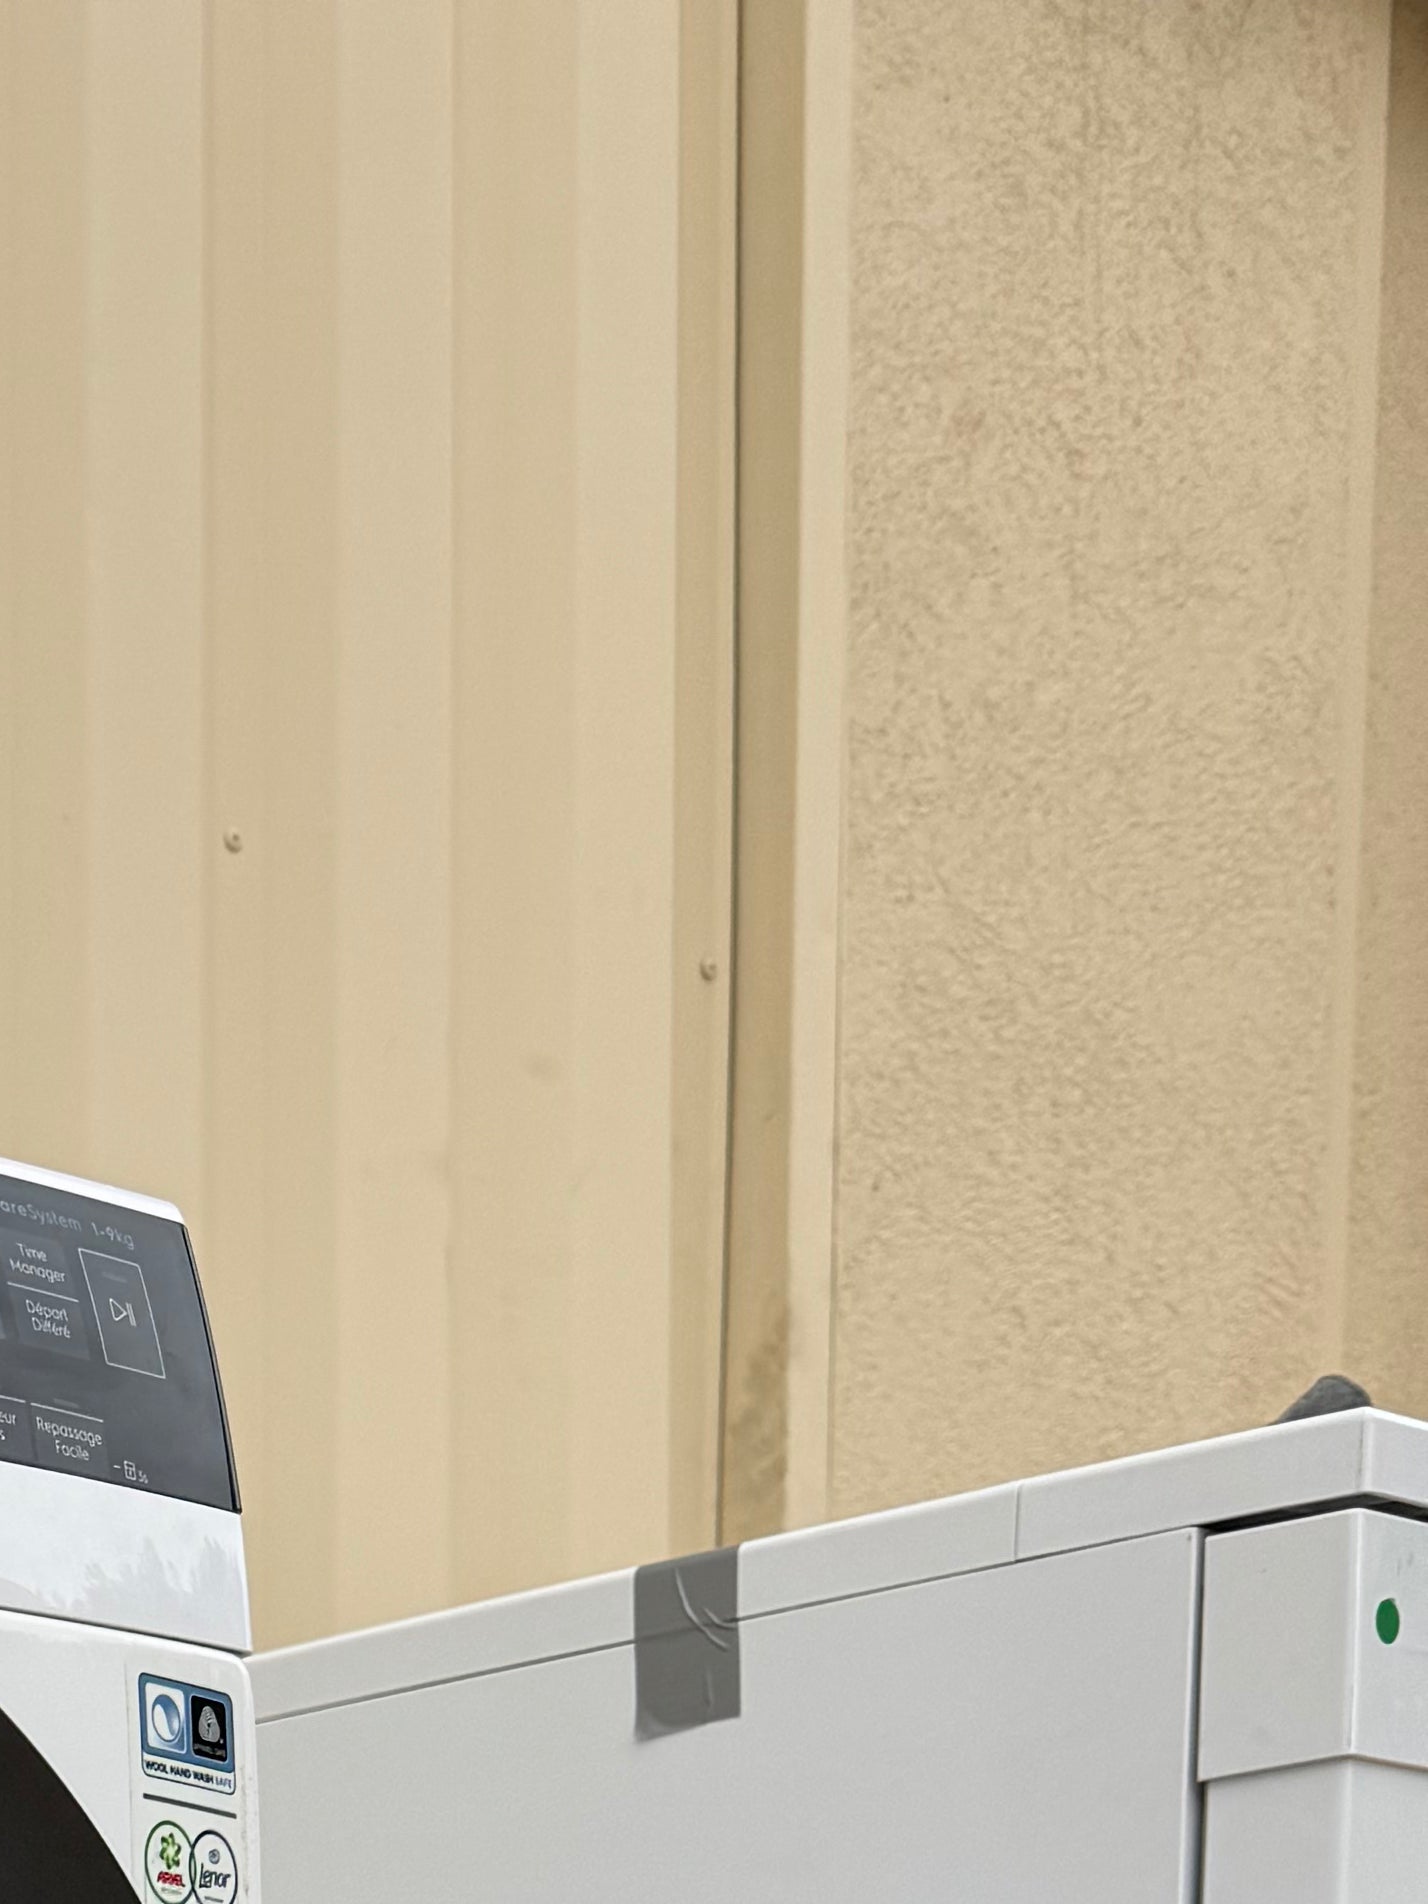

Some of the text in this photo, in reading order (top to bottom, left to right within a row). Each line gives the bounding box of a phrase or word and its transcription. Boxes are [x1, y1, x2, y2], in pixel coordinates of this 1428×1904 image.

[15, 1242, 48, 1263] Time
[8, 1258, 66, 1284] Manager
[35, 1415, 104, 1448] Repassage
[54, 1439, 91, 1462] Facile
[198, 1861, 232, 1889] Lenor
